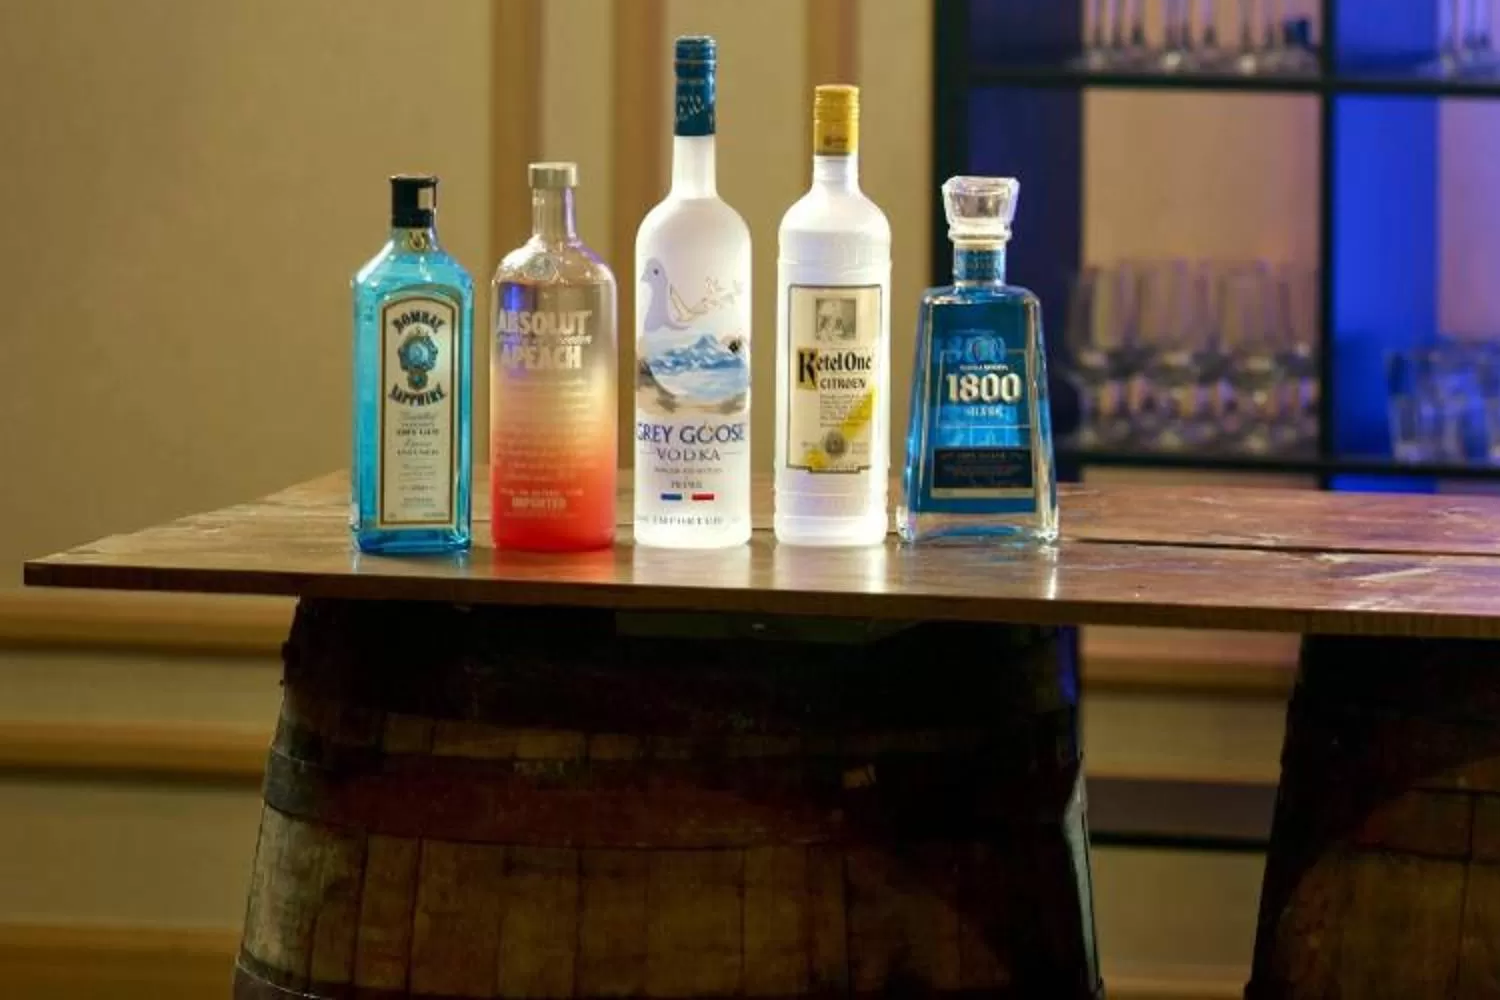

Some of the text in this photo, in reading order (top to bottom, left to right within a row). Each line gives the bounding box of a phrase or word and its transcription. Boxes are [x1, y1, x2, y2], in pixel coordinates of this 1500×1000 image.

[393, 311, 445, 334] BOMBAY
[496, 308, 593, 335] ABSOLUT
[946, 372, 1022, 404] 1800
[679, 423, 746, 445] GOOSE
[656, 447, 721, 461] VODKA
